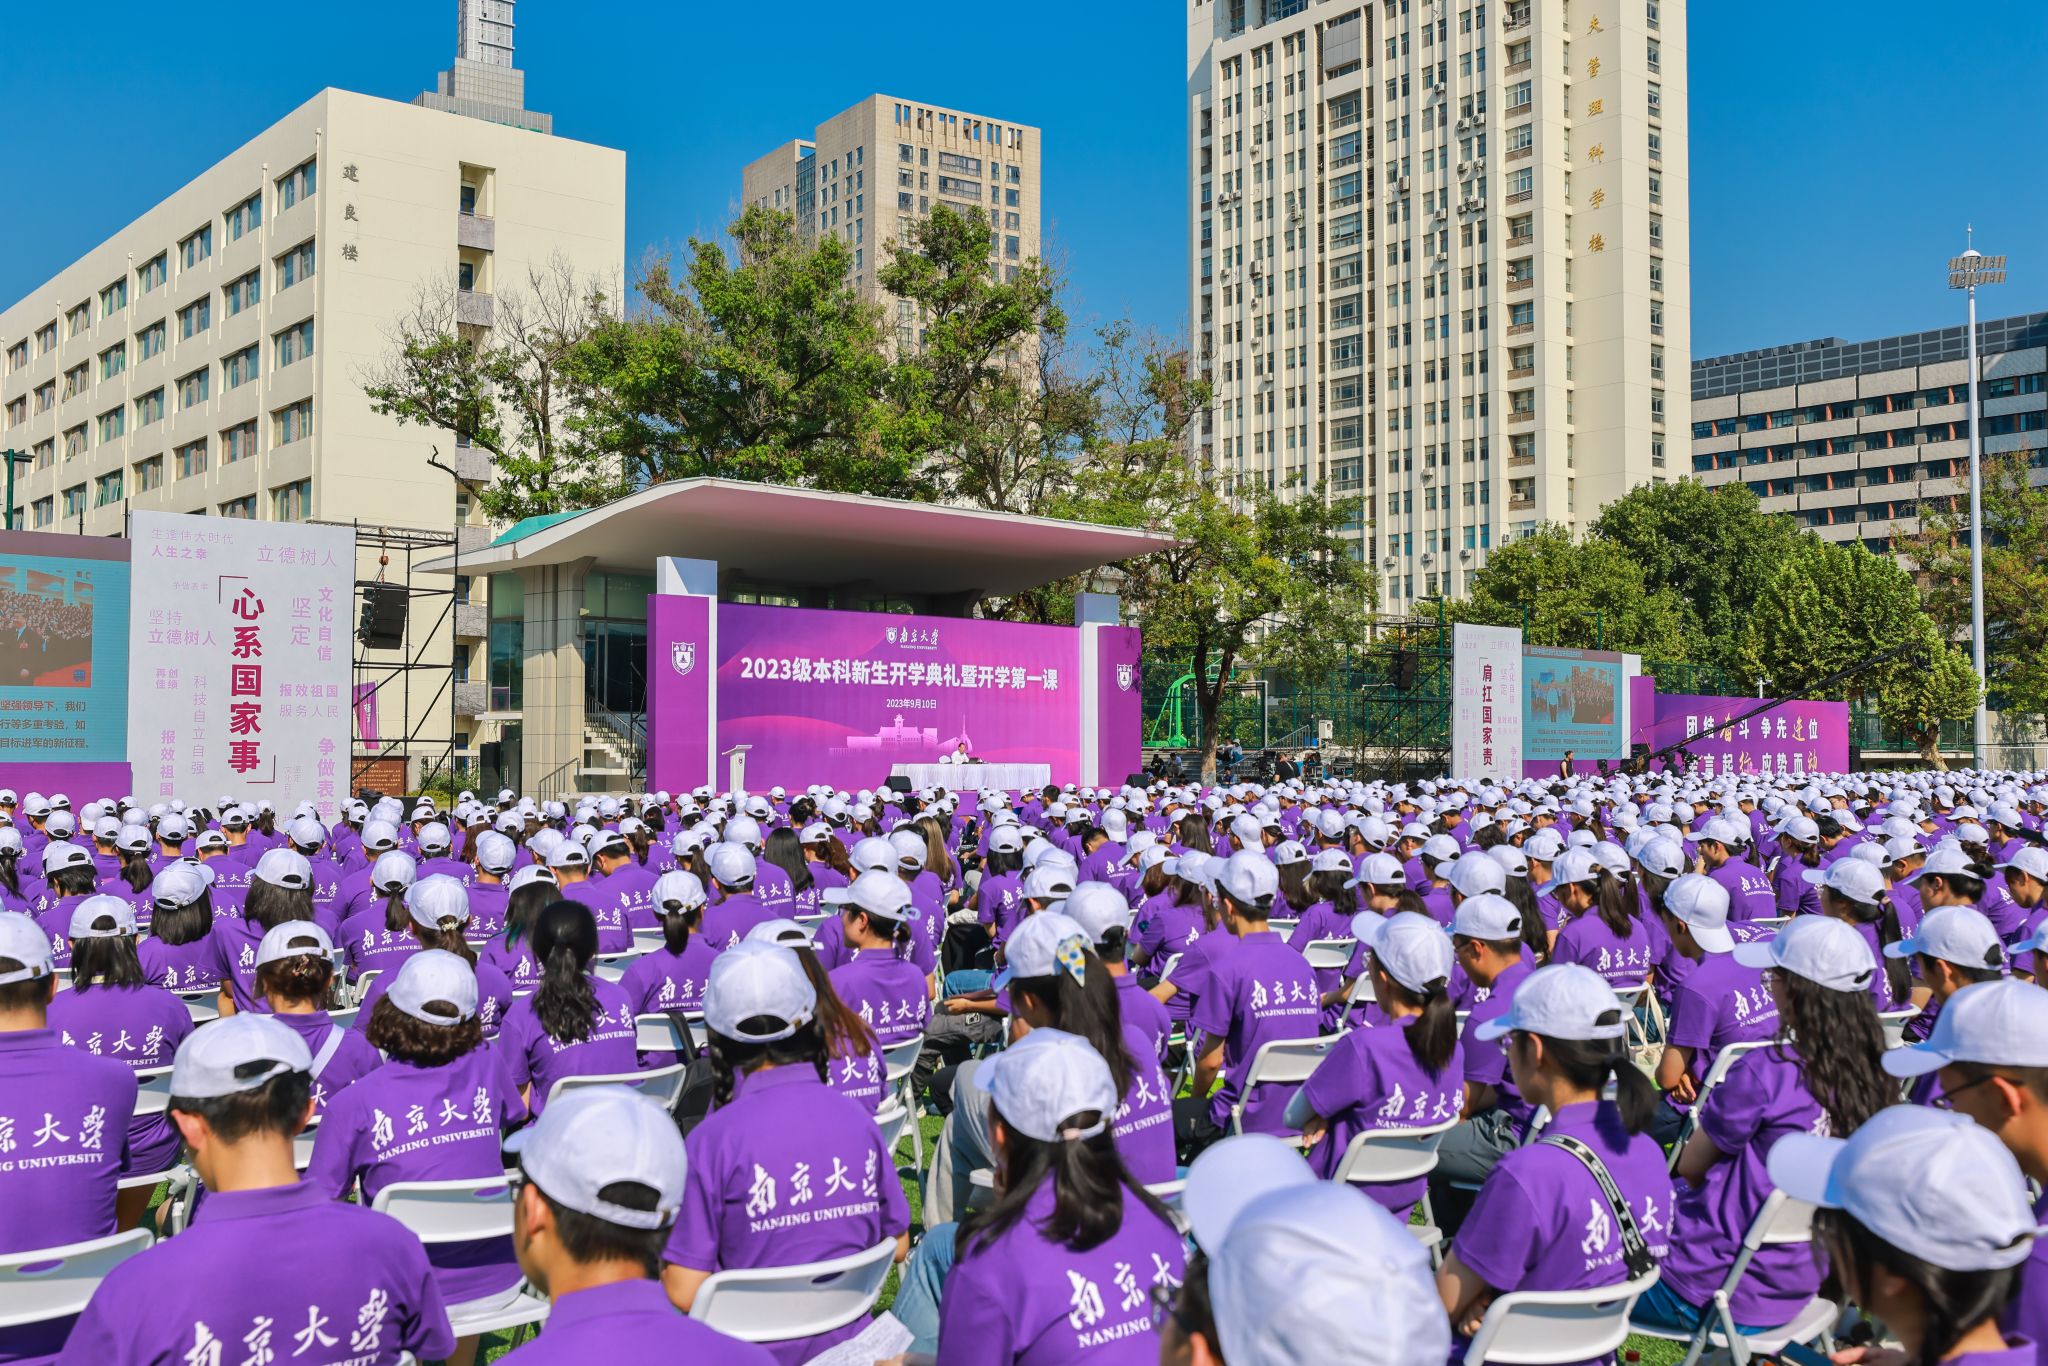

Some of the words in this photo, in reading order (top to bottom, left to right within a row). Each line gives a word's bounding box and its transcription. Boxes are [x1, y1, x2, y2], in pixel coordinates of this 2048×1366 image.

[341, 163, 360, 263] 建良楼
[151, 527, 234, 545] 生逢伟大时代
[151, 544, 208, 560] 人生之幸
[257, 543, 337, 567] 立德树人
[148, 608, 182, 626] 坚持
[290, 597, 311, 646] 坚定
[317, 586, 334, 662] 文化自信
[147, 627, 217, 647] 立德树人
[227, 587, 265, 774] 心系国家事
[740, 656, 1058, 691] 2023级本科新生开学典礼暨开学第一课
[280, 683, 338, 698] 报效祖国
[886, 698, 937, 709] 2023年9月10日
[191, 674, 208, 775] 科技自立自强
[280, 704, 338, 718] 服务人民
[1482, 663, 1493, 766] 肩扛国家责
[160, 729, 176, 797] 报效祖国
[316, 737, 336, 819] 争做表率
[18, 1152, 105, 1170] UNIVERSITY
[377, 1137, 429, 1163] NANJING
[432, 1126, 495, 1146] UNIVERSITY
[750, 1211, 811, 1234] NANJING
[1077, 1316, 1151, 1349] NANJING
